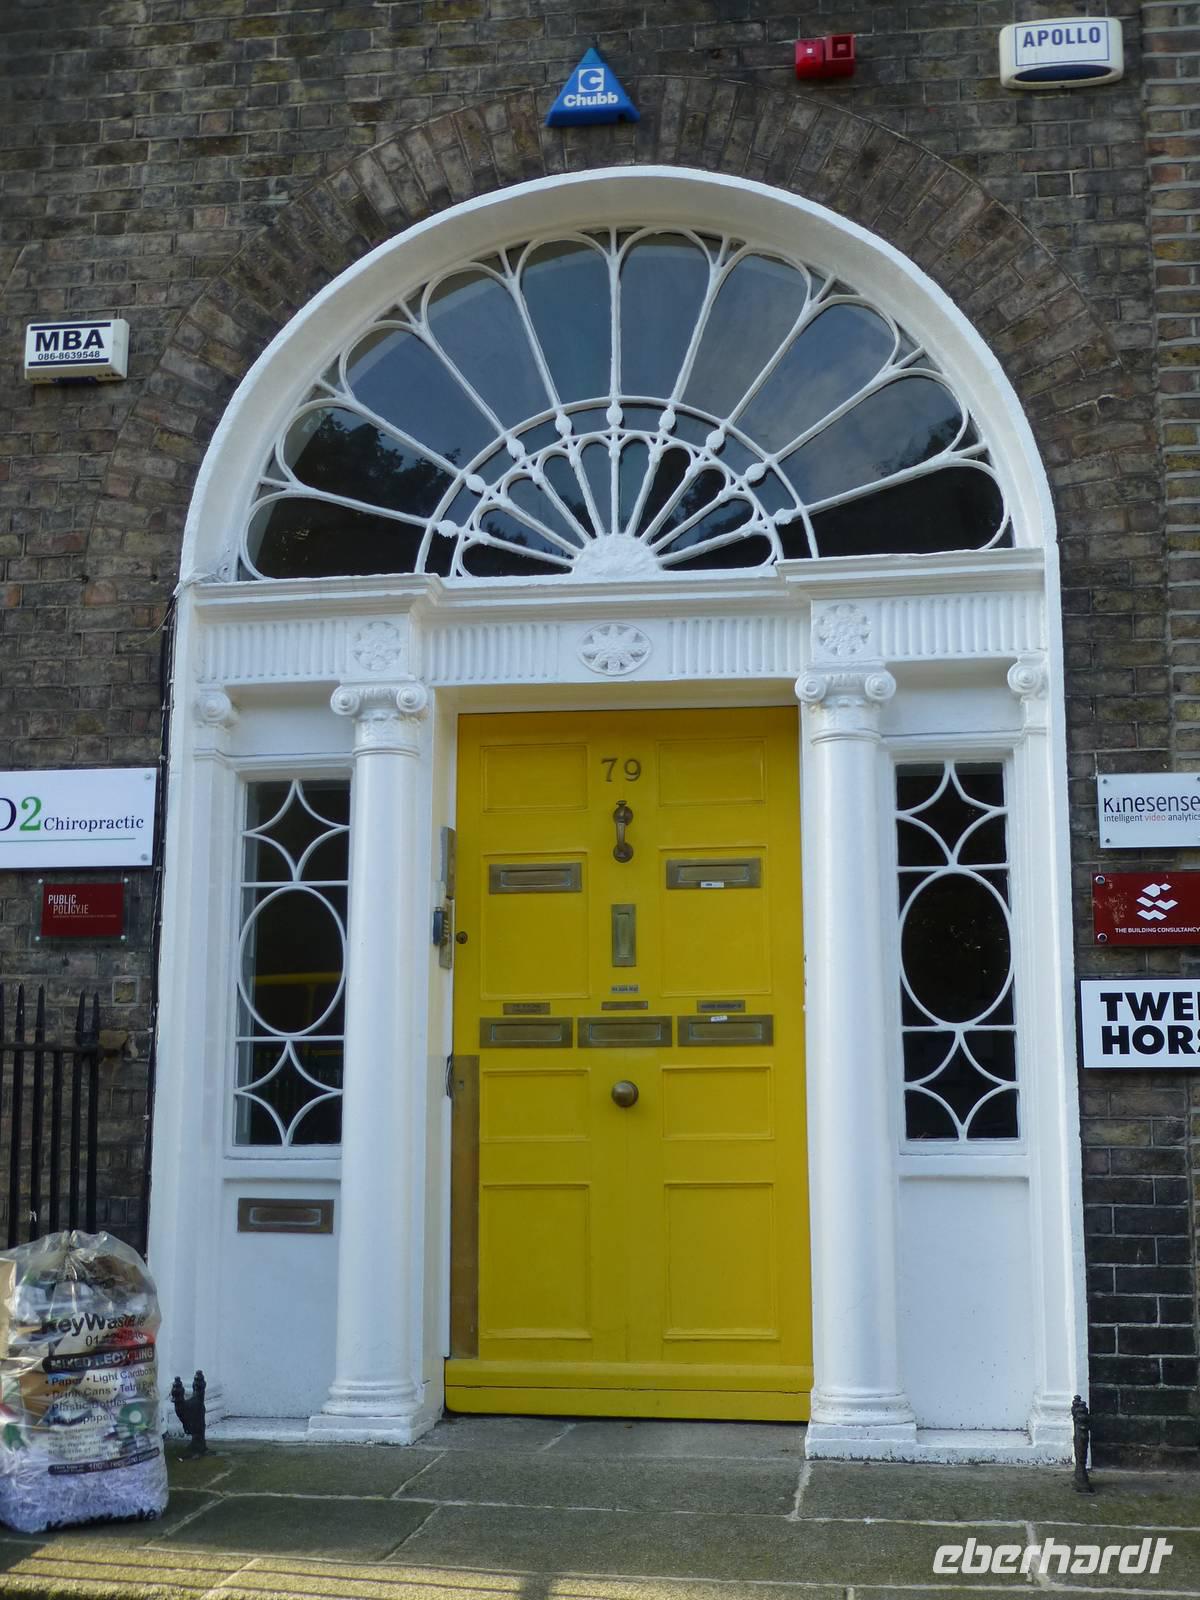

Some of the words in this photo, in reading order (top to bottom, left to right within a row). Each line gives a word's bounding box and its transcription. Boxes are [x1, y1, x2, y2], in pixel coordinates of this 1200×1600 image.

[1023, 27, 1101, 48] APOLLO
[563, 92, 619, 107] Chubb
[35, 329, 105, 352] MBA
[37, 350, 101, 361] 086-8639548
[601, 758, 641, 782] 79
[1103, 795, 1200, 813] Kinesense
[44, 815, 144, 832] Chiropractic
[1104, 813, 1143, 823] intelligent
[1144, 813, 1167, 822] video
[48, 894, 77, 906] PUBLIC
[1100, 991, 1200, 1021] TWE
[1101, 1025, 1200, 1055] HOR
[93, 1371, 118, 1384] Light
[84, 1387, 111, 1398] Cans
